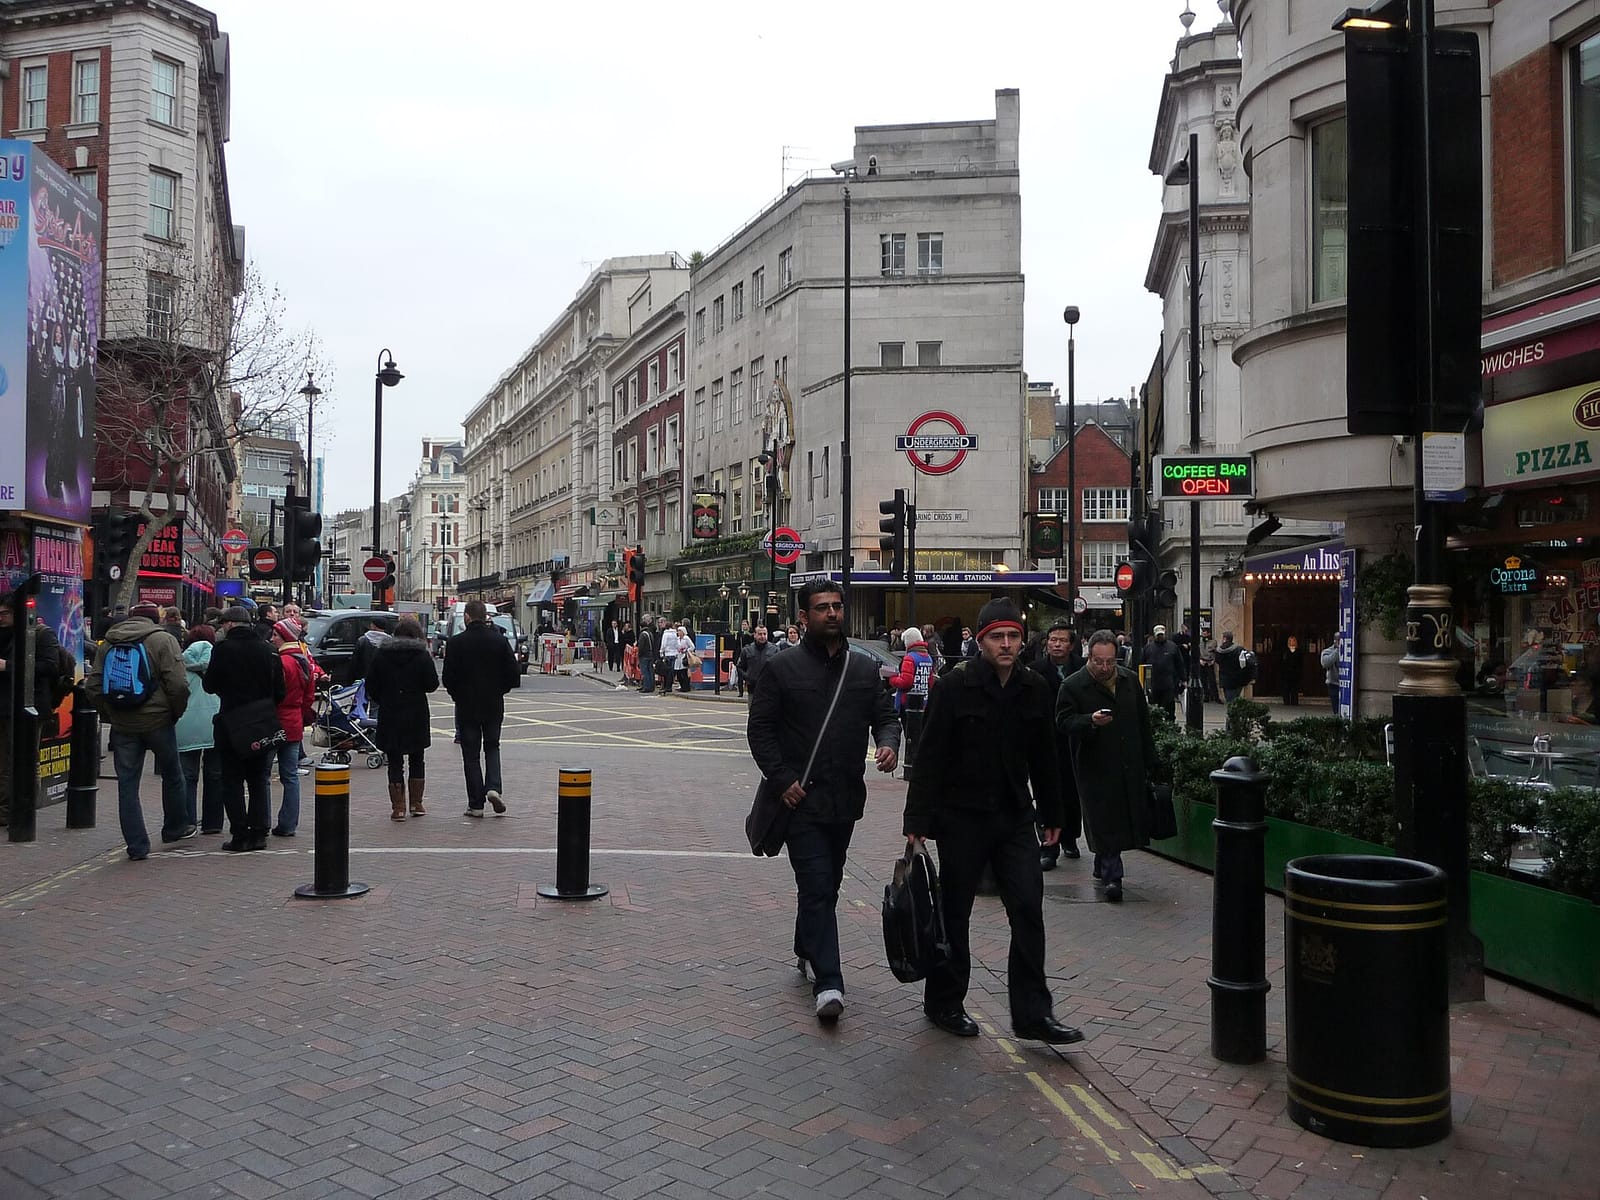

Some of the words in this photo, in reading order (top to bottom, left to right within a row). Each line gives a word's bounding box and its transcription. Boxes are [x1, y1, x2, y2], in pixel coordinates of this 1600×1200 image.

[904, 436, 970, 449] UNDERGROUND
[1516, 440, 1592, 475] PIZZA
[1220, 463, 1247, 477] BAR
[1182, 479, 1230, 494] OPEN
[933, 512, 952, 521] CROSS
[34, 536, 81, 574] PRISCILLA
[141, 554, 180, 568] OUSES
[1303, 553, 1317, 570] An
[1318, 548, 1340, 570] Ins
[932, 574, 959, 582] SQUARE
[964, 574, 992, 582] STATION
[1490, 567, 1537, 585] Corona
[1501, 582, 1527, 592] Extra
[1549, 586, 1600, 625] CAFE
[1551, 630, 1599, 646] PIZZA
